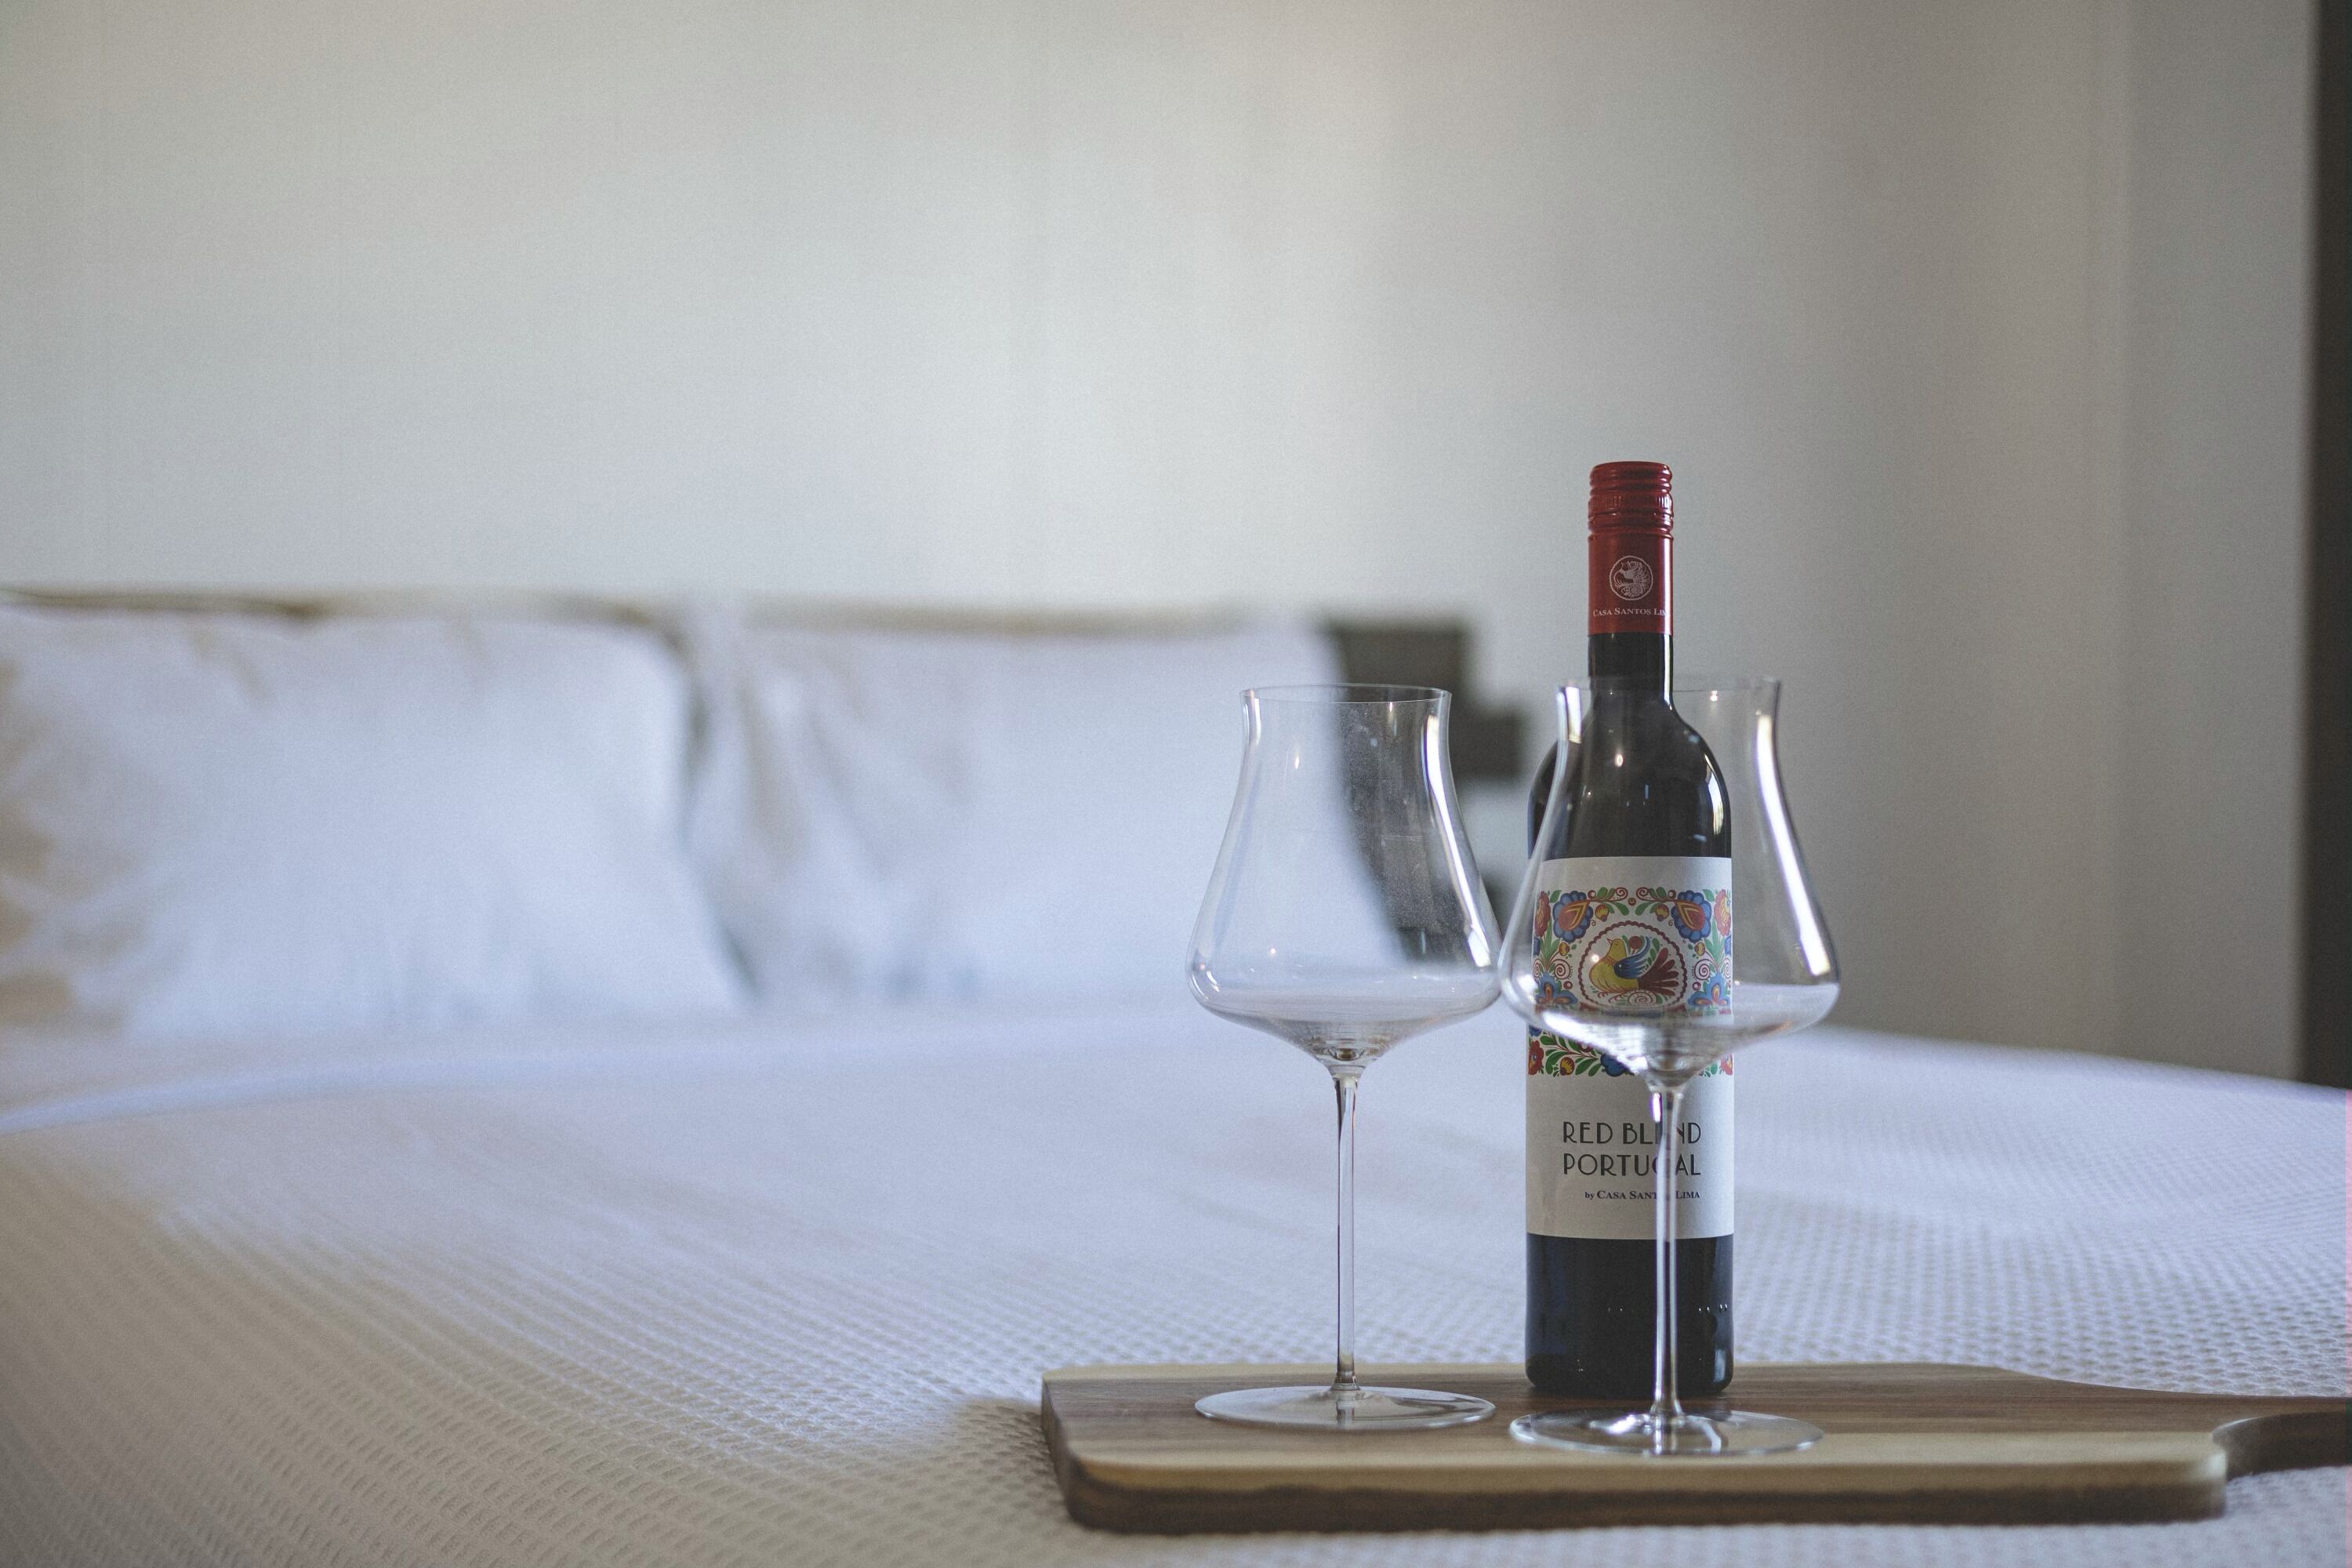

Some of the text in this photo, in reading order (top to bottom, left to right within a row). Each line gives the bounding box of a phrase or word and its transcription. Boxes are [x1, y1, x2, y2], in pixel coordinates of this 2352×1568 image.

[1563, 1121, 1613, 1144] RED
[1563, 1153, 1701, 1176] PORTUAL
[1584, 1192, 1595, 1200] by
